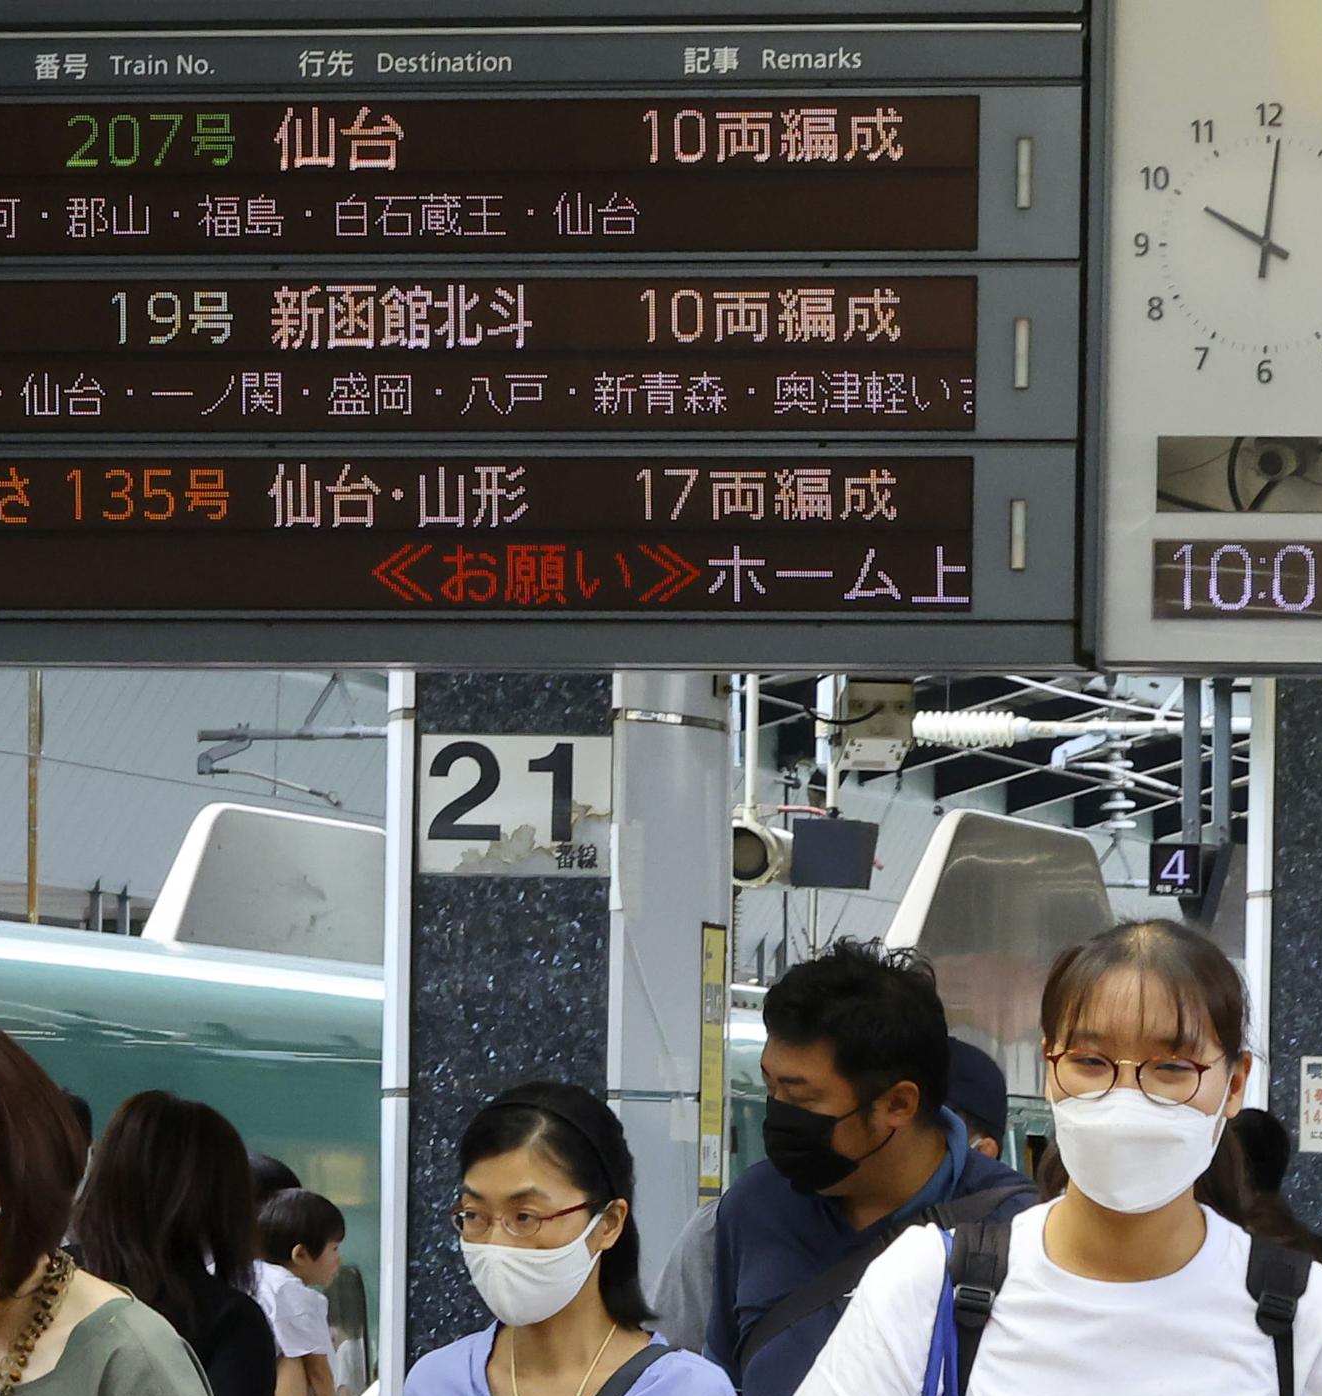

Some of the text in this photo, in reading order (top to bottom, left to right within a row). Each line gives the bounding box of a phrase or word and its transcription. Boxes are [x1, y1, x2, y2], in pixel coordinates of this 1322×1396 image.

[34, 53, 89, 80] 番号
[109, 54, 168, 76] Train
[176, 54, 215, 75] No.
[298, 50, 354, 77] 行先
[377, 50, 512, 73] Destination
[683, 46, 739, 74] 記事
[762, 47, 862, 70] Remarks
[1256, 102, 1283, 128] 12
[66, 113, 236, 168] 207号
[273, 106, 405, 171] 仙台
[642, 107, 904, 164] 10両編成
[1191, 119, 1213, 144] 11
[1140, 165, 1170, 191] 10
[1133, 232, 1150, 258] 9
[111, 291, 234, 345] 19号
[270, 284, 533, 350] 新函館北斗
[640, 288, 901, 343] 10両編成
[1147, 296, 1164, 322] 8
[1194, 346, 1210, 371] 7
[1256, 359, 1273, 385] 6
[66, 468, 230, 521] 135号
[636, 468, 897, 521] 17両編成
[427, 740, 574, 842] 21
[1160, 849, 1191, 886] 4
